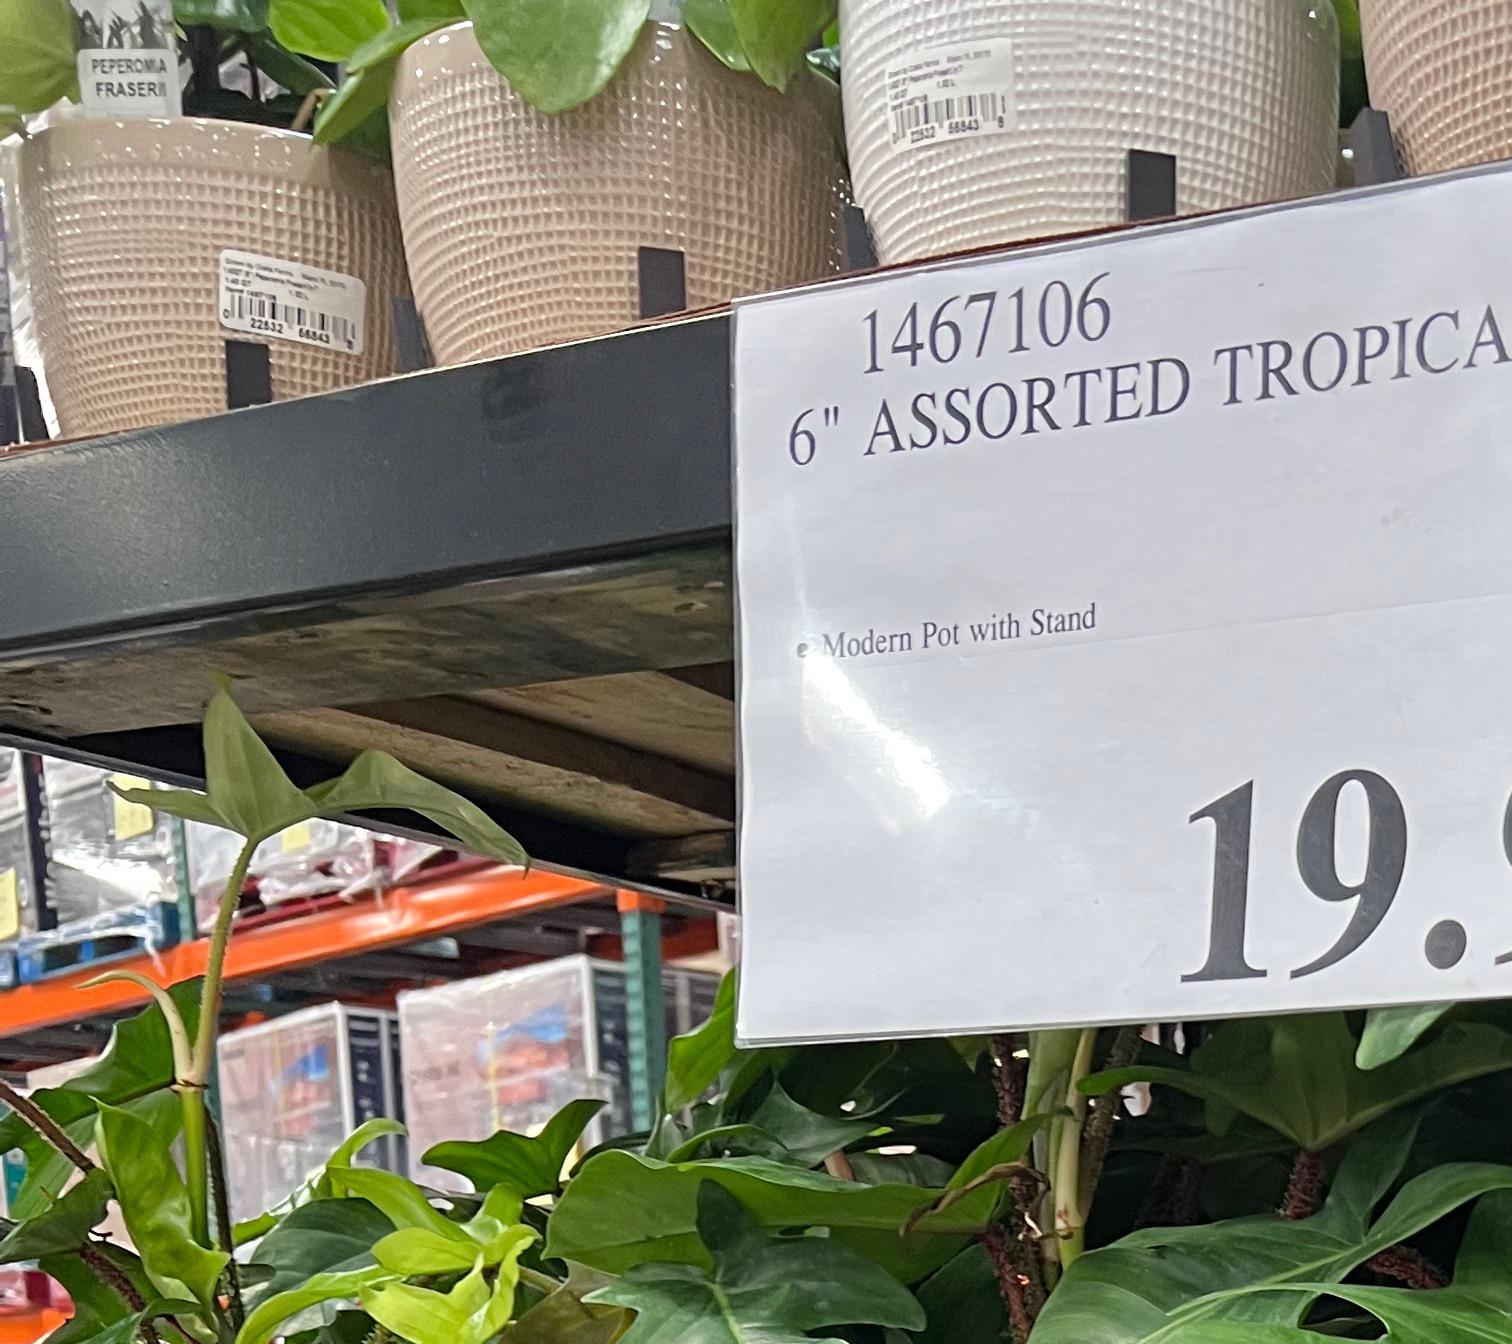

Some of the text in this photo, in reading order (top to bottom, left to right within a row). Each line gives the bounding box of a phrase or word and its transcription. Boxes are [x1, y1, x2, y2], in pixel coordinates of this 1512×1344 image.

[862, 271, 1112, 376] 1467106
[787, 405, 840, 467] 6"
[862, 356, 1191, 458] ASSORTED
[822, 601, 1097, 658] Modern Pot with Stand
